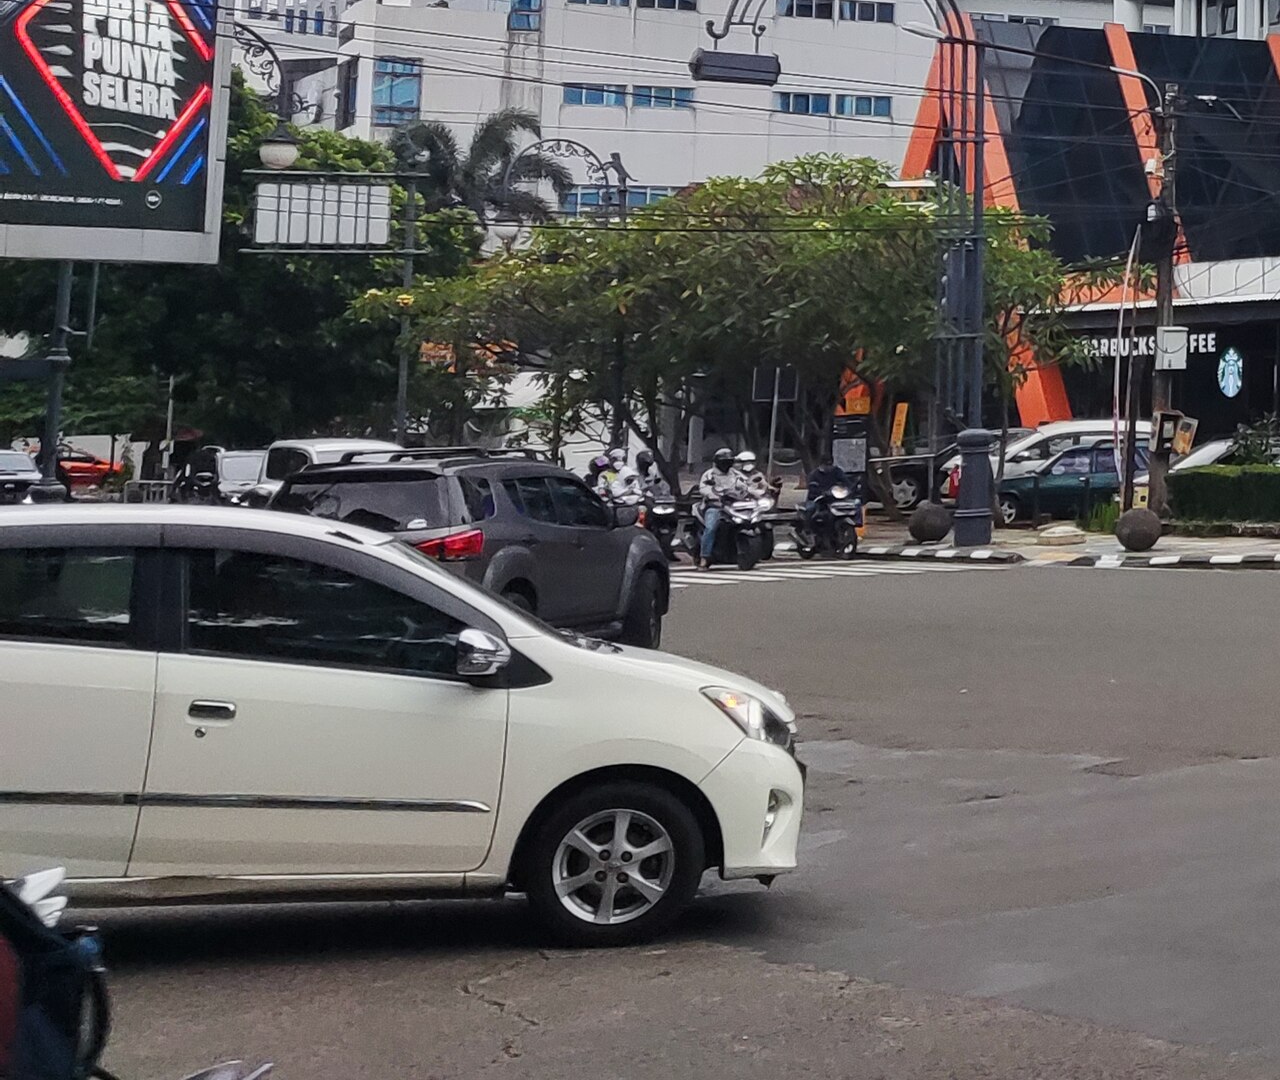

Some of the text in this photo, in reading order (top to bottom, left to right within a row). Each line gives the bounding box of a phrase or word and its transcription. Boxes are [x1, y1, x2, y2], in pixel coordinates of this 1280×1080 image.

[83, 32, 175, 87] PUNYA
[83, 70, 177, 121] SELERA
[1080, 336, 1156, 357] TARBUCKS
